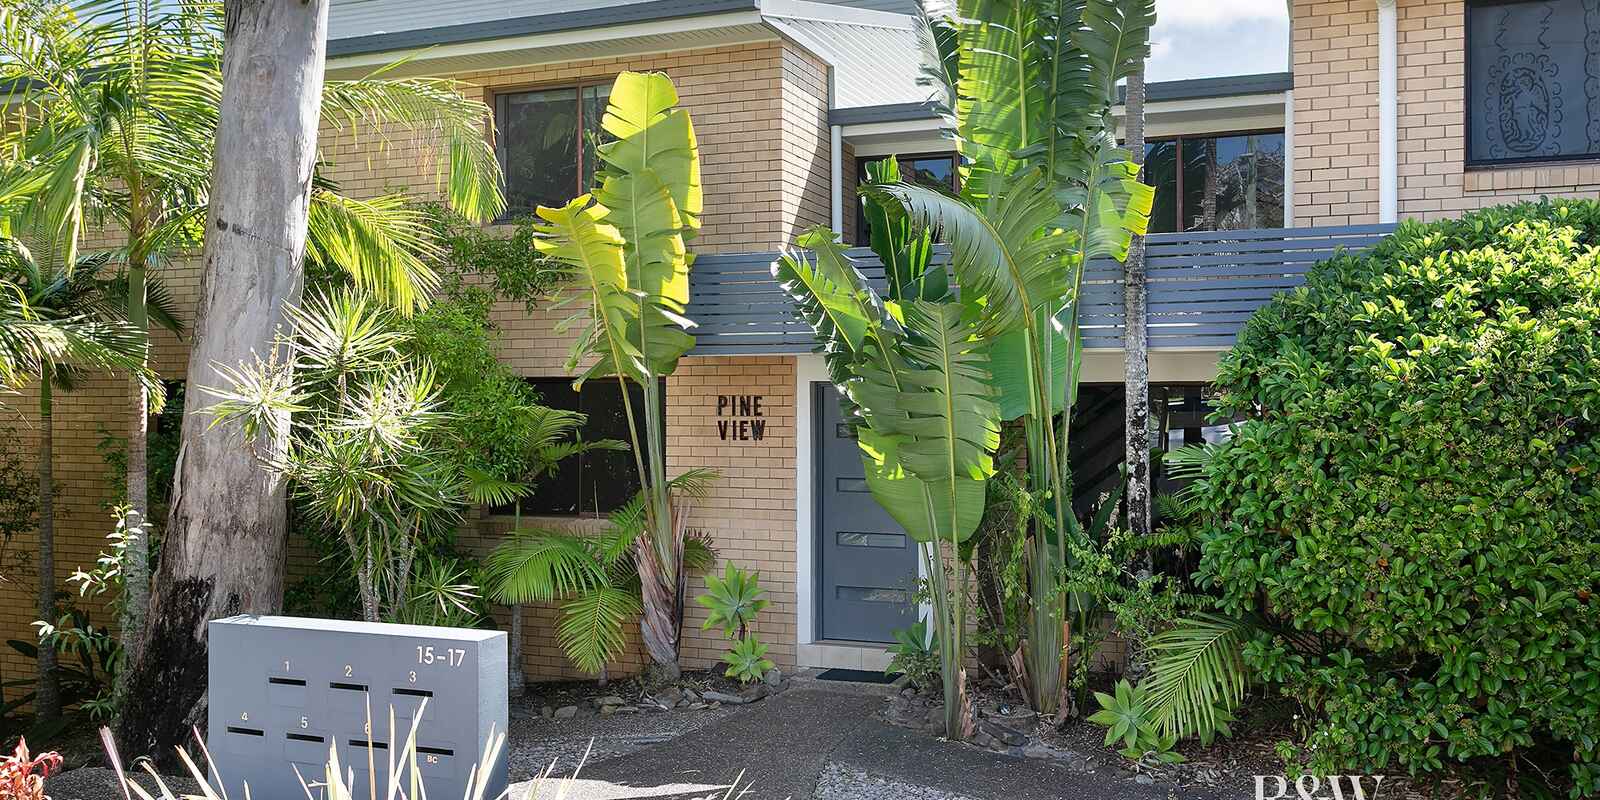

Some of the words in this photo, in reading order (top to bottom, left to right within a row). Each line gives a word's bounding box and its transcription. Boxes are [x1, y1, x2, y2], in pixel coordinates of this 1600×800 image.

[717, 395, 763, 417] PINE
[717, 419, 766, 441] VIEW
[416, 645, 466, 667] 15-17
[284, 660, 290, 673] 1
[344, 664, 353, 678] 2
[408, 670, 417, 683] 3
[241, 711, 249, 721] 4
[300, 715, 308, 729] 5
